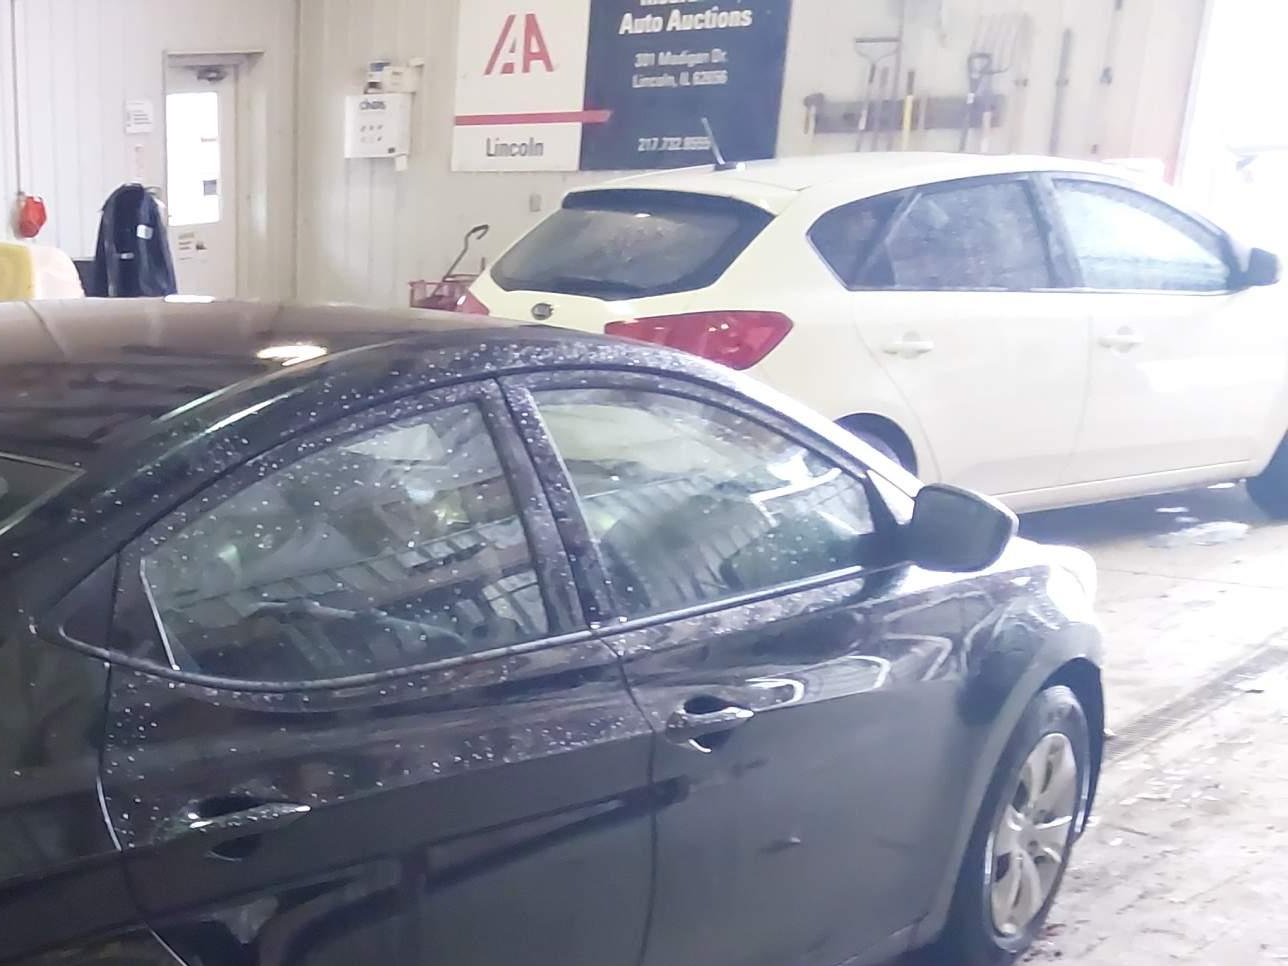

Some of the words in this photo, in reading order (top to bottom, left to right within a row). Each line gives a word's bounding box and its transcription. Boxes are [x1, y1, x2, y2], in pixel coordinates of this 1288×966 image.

[618, 12, 664, 35] Auto
[666, 6, 753, 32] Auctions
[485, 136, 545, 158] Lincoln
